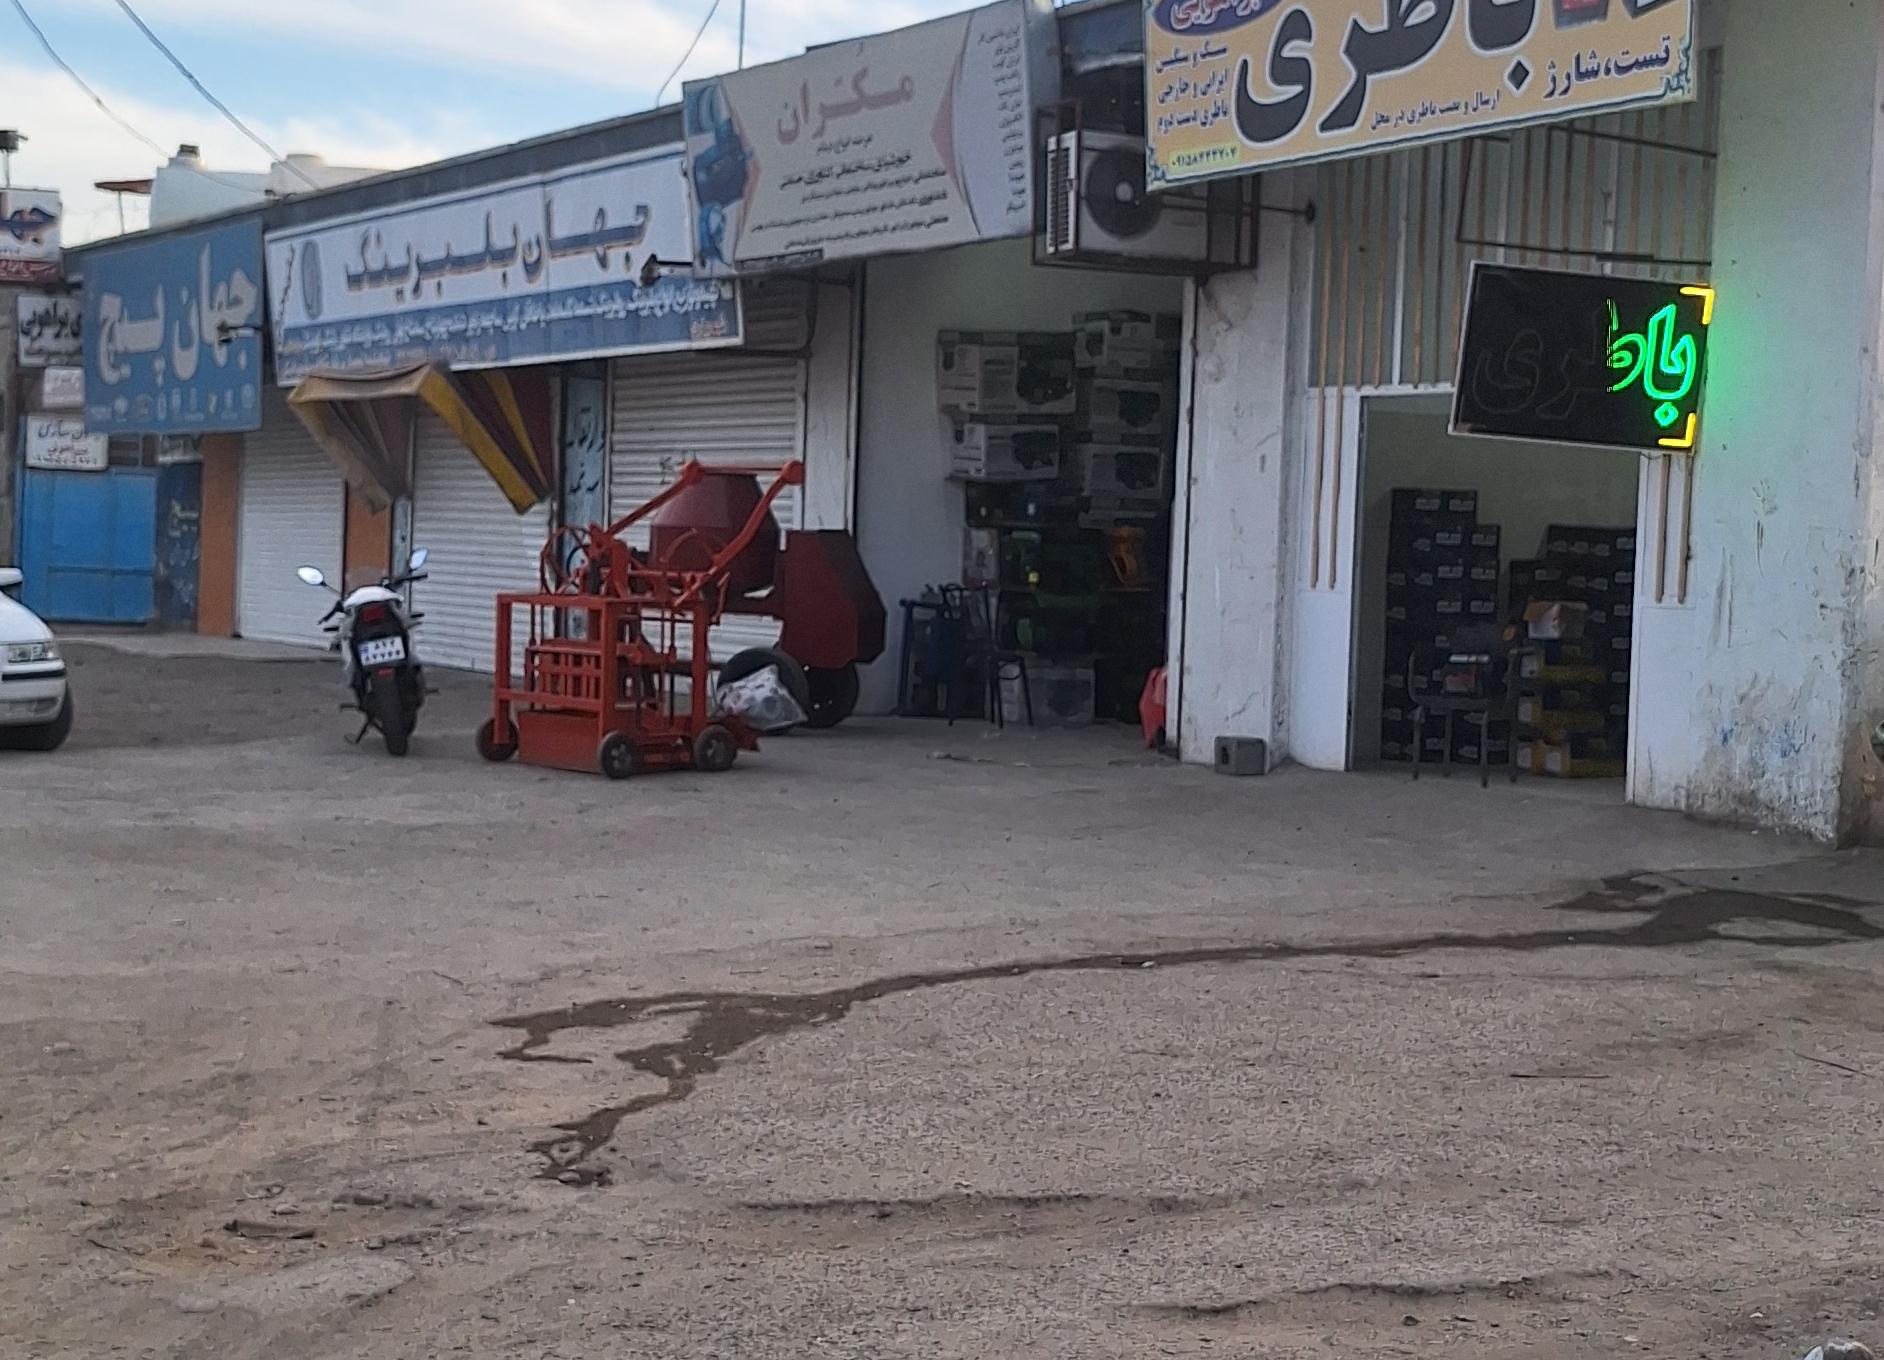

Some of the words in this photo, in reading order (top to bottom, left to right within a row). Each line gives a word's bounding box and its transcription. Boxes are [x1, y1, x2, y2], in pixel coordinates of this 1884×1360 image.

[1471, 89, 1499, 113] ارسال
[0, 192, 55, 245] جها
[345, 209, 518, 302] بلبرینگ
[522, 198, 650, 283] جهان
[166, 241, 258, 382] جهان
